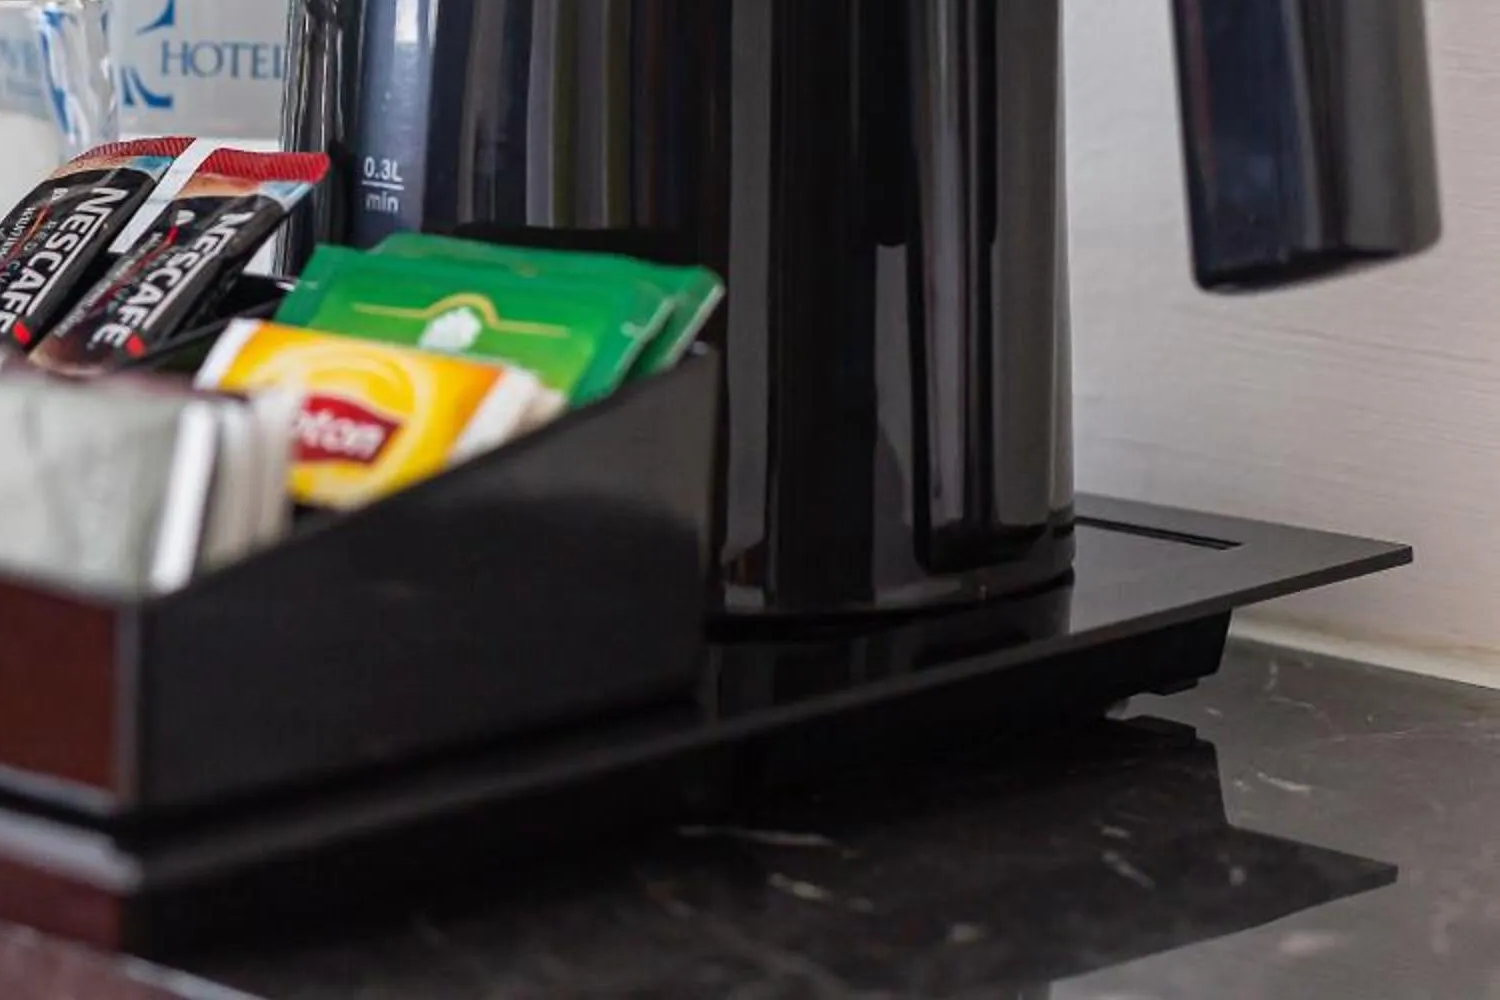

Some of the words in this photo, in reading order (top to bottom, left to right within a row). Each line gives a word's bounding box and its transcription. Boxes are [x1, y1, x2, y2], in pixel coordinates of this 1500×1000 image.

[364, 156, 404, 182] 0.3L
[366, 190, 399, 213] min
[297, 409, 384, 458] ton
